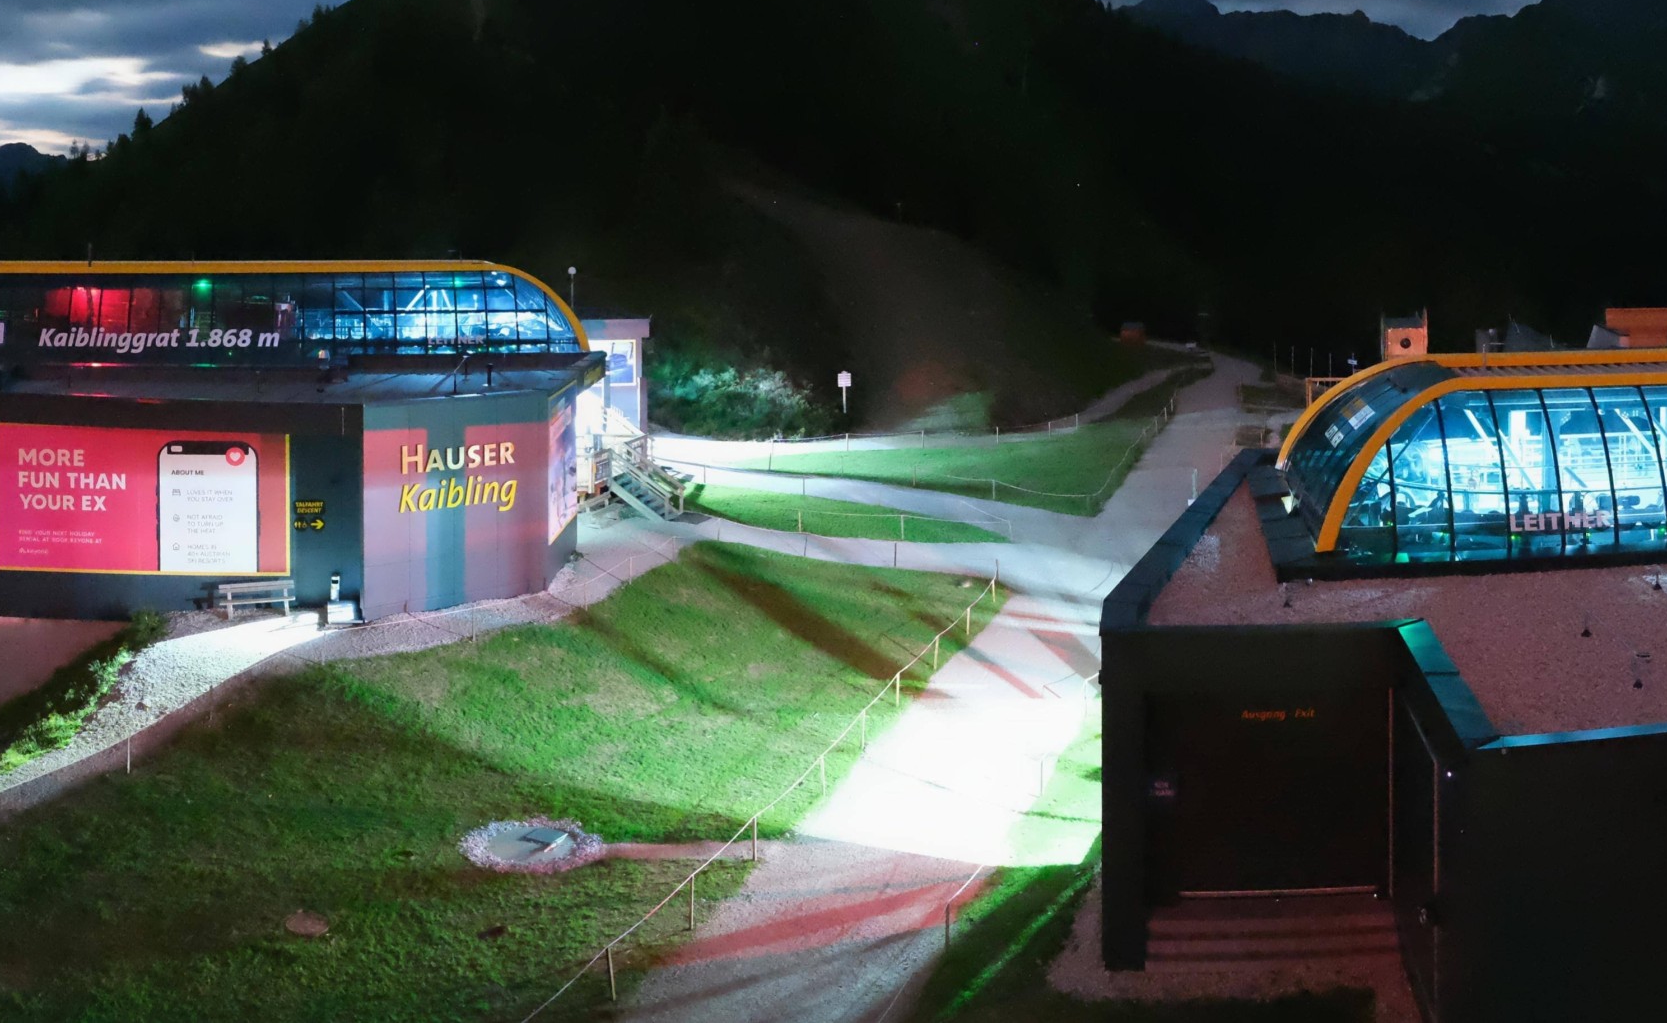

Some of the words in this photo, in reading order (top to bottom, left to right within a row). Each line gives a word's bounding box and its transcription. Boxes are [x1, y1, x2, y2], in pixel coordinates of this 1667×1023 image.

[38, 328, 180, 354] Kaiblinggrat
[185, 328, 252, 348] 1.868
[257, 332, 280, 348] m
[18, 448, 85, 467] MORE
[400, 441, 516, 475] HAUSER
[18, 471, 60, 489] FUN
[66, 472, 127, 490] THAN
[20, 493, 75, 511] YOUR
[81, 495, 107, 511] EX
[399, 475, 518, 514] Kaibling
